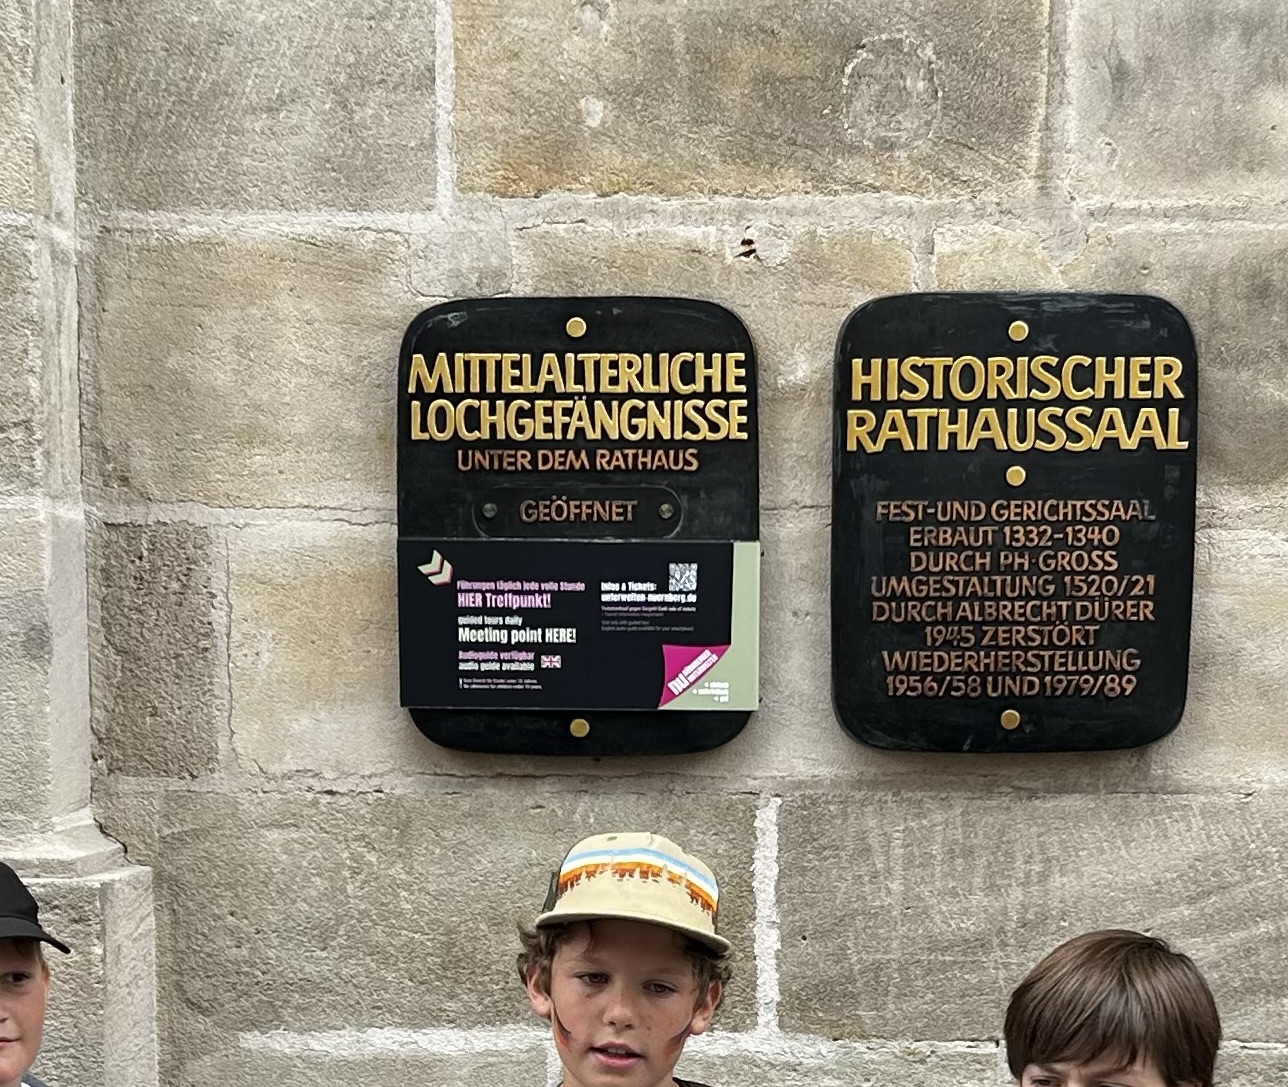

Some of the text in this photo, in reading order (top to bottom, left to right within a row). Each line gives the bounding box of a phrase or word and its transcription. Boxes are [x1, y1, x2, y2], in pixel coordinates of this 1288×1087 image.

[407, 352, 747, 394] MITTELALTERLICHE
[850, 355, 1185, 401] HISTORISCHER
[410, 396, 748, 442] LOCHGEFÄNGNISSE
[845, 406, 1189, 453] RATHAUSSAAL
[457, 448, 699, 471] UNTER DEM RATHAUS
[519, 495, 637, 523] GEÖFFNET
[990, 499, 1156, 521] GERICHTSSAAL
[909, 525, 1120, 547] ERBAUT 1332-1340
[910, 551, 991, 572] DURCH
[871, 574, 1155, 598] UMGESTALTUNG 1520/21
[457, 592, 551, 610] HIER Treffpunkt!
[872, 597, 1155, 622] DURCH ALBRECHT DÜRER
[457, 615, 523, 626] guided tours daily
[458, 627, 576, 645] Meeting point HERE!
[924, 620, 1099, 647] 1945 ZERSTÖRT
[882, 650, 1141, 673] WIEDERHERSTELLUNG
[886, 676, 1137, 698] 1956/58 UND 1979/89
